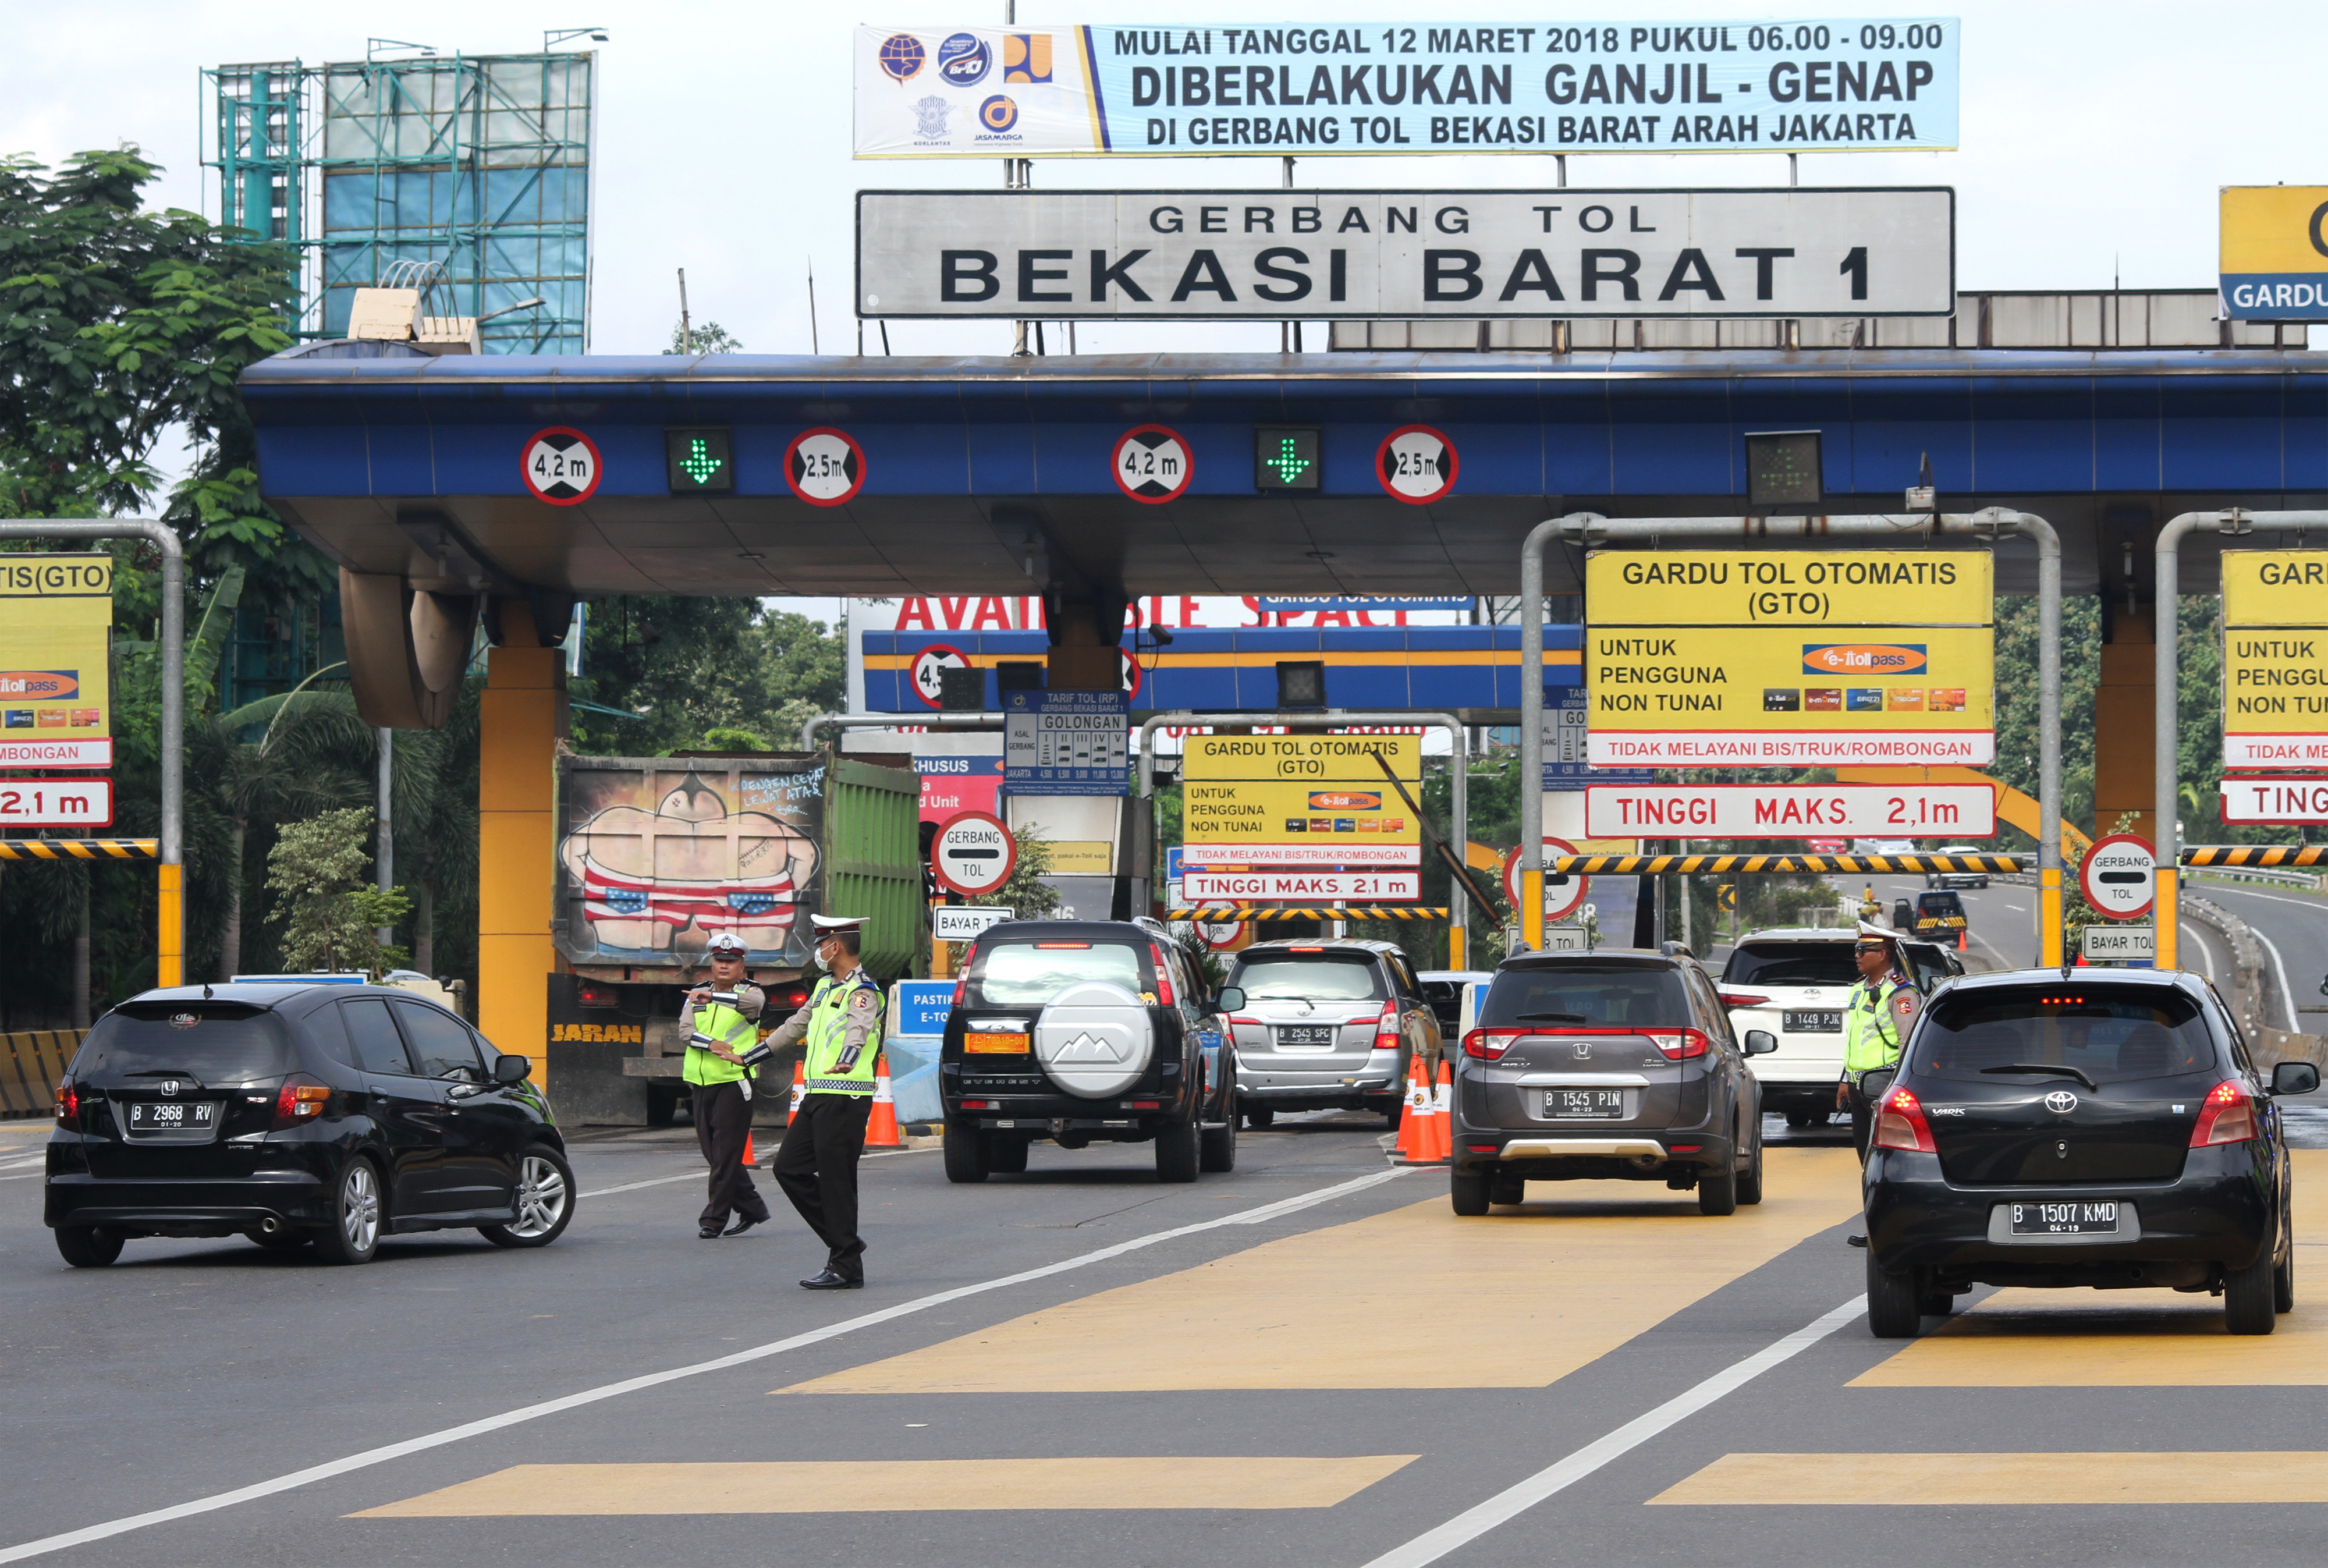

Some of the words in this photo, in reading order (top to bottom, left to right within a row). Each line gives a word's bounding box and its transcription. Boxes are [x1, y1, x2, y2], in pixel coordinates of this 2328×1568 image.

[1115, 31, 1211, 56] MULAI
[1223, 30, 1371, 55] TANGGAL
[1382, 29, 1416, 54] 12
[1428, 28, 1535, 54] MARET
[1546, 28, 1619, 53] 2018
[1631, 26, 1737, 52] PUKUL
[1748, 25, 1830, 51] 06.00
[1860, 24, 1943, 49] 09.00
[1133, 64, 1512, 107] DIBERLAKUKAN
[1545, 63, 1723, 104] GANJIL
[1738, 82, 1752, 93] -
[1768, 61, 1934, 103] GENAP
[1147, 118, 1180, 145] DI
[1188, 118, 1340, 145] GERBANG
[1350, 116, 1410, 144] TOL
[1430, 116, 1545, 144] BEKASI
[1558, 115, 1660, 143] BARAT
[1671, 115, 1759, 143] ARAH
[1770, 113, 1917, 142] JAKARTA
[1149, 206, 1470, 234] GERBANG
[1532, 205, 1657, 233] TOL
[941, 247, 1346, 302] BEKASI
[1424, 247, 1795, 301] BARAT
[1840, 246, 1868, 300] 1
[535, 454, 565, 478] 4,2
[570, 459, 587, 476] m
[807, 454, 842, 478] 2,5m
[1125, 452, 1155, 476] 4,2
[1162, 456, 1178, 475] m
[1399, 452, 1435, 476] 2,5m
[1623, 562, 1729, 585] GARDU
[1739, 562, 1795, 584] TOL
[1804, 562, 1956, 584] OTOMATIS
[2259, 562, 2328, 585] GAR
[1748, 592, 1830, 620] (GTO)
[1600, 640, 1676, 657] UNTUK
[2237, 641, 2315, 658] UNTUK
[1600, 666, 1727, 684] PENGGUNA
[1047, 693, 1074, 703] TARIF
[1077, 693, 1094, 703] TOL
[1098, 693, 1118, 704] (RP)
[1600, 694, 1648, 711] NON
[1655, 694, 1722, 711] TUNAI
[2238, 697, 2286, 713] NON
[1045, 715, 1120, 729] GOLONGAN
[1077, 734, 1087, 742] III
[1094, 734, 1105, 742] IV
[1204, 742, 1267, 755] GARDU
[1272, 742, 1304, 755] TOL
[1309, 741, 1399, 755] OTOMATIS
[1608, 742, 1662, 756] TIDAK
[1667, 742, 1756, 756] MELAYANI
[1762, 742, 1972, 757] BIS/TRUK/ROMBONGAN
[2245, 745, 2300, 758] TIDAK
[1006, 769, 1031, 778] JAKARTA
[1276, 760, 1324, 777] (GTO)
[1191, 787, 1236, 799] UNTUK
[1, 792, 43, 816] 2,1
[60, 795, 89, 813] m
[930, 796, 959, 808] Unit
[1190, 804, 1265, 816] PENGGUNA
[1616, 798, 1716, 825] TINGGI
[1754, 797, 1853, 825] MAKS.
[1887, 797, 1960, 828] 2,1m
[1191, 821, 1221, 832] NON
[1224, 821, 1262, 832] TUNAI
[947, 831, 1000, 845] GERBANG
[1196, 850, 1227, 859] TIDAK
[1230, 850, 1283, 860] MELAYANI
[1285, 850, 1407, 860] BIS/TRUK/ROMBONGAN
[2095, 856, 2150, 868] GERBANG
[962, 863, 985, 877] TOL
[1197, 879, 1266, 893] TINGGI
[1276, 879, 1343, 893] MAKS.
[1353, 879, 1379, 896] 2,1
[1388, 882, 1407, 893] m
[2111, 888, 2133, 899] TOL
[941, 917, 980, 930] BAYAR
[2091, 936, 2129, 950] BAYAR
[1785, 1013, 1791, 1024] B
[1798, 1013, 1818, 1025] 1449
[1823, 1013, 1840, 1025] PJK
[551, 1024, 642, 1044] JARAN
[986, 1036, 1024, 1045] 70310-00
[1279, 1028, 1284, 1038] B
[1291, 1028, 1310, 1038] 2545
[1315, 1028, 1329, 1038] SFC
[1546, 1092, 1553, 1106] B
[1563, 1092, 1590, 1106] 1545
[1599, 1092, 1620, 1106] PIN
[133, 1106, 141, 1121] B
[153, 1106, 183, 1121] 2968
[196, 1105, 211, 1120] RV
[1932, 1107, 1966, 1116] YARIS
[2014, 1205, 2023, 1223] B
[2039, 1204, 2077, 1223] 1507
[2085, 1203, 2116, 1222] KMD
